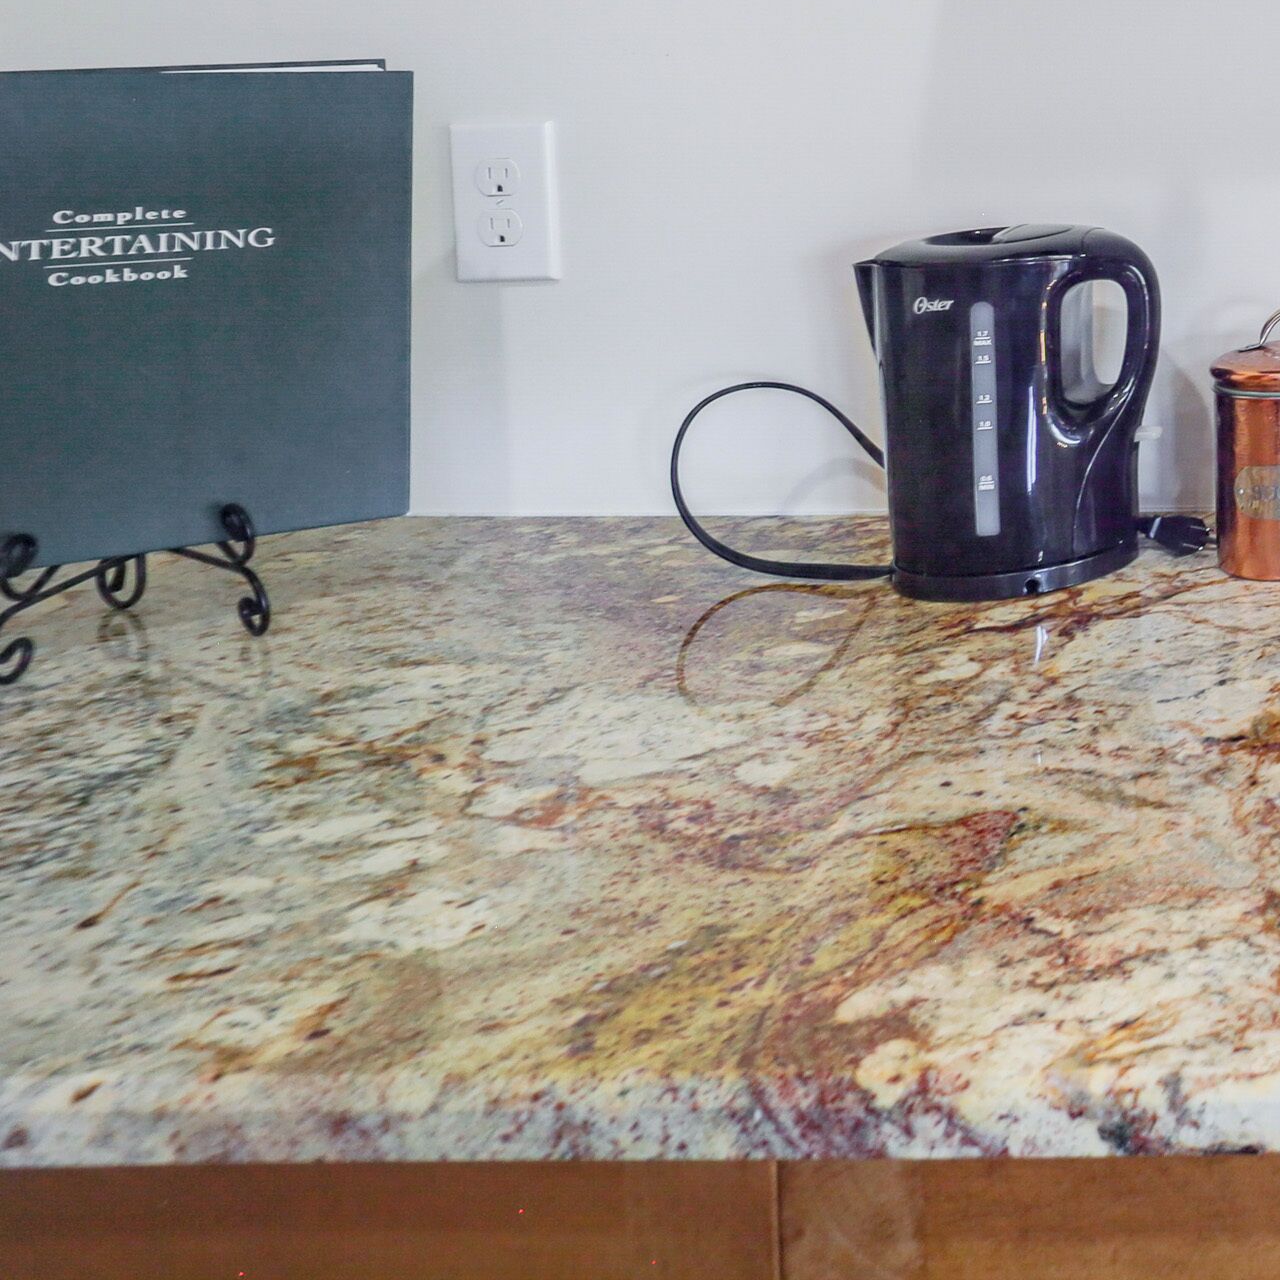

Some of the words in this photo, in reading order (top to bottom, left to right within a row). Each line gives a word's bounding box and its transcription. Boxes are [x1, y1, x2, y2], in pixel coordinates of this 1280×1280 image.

[52, 206, 188, 226] Complete
[47, 264, 189, 287] Cookbook
[913, 296, 955, 315] Oster
